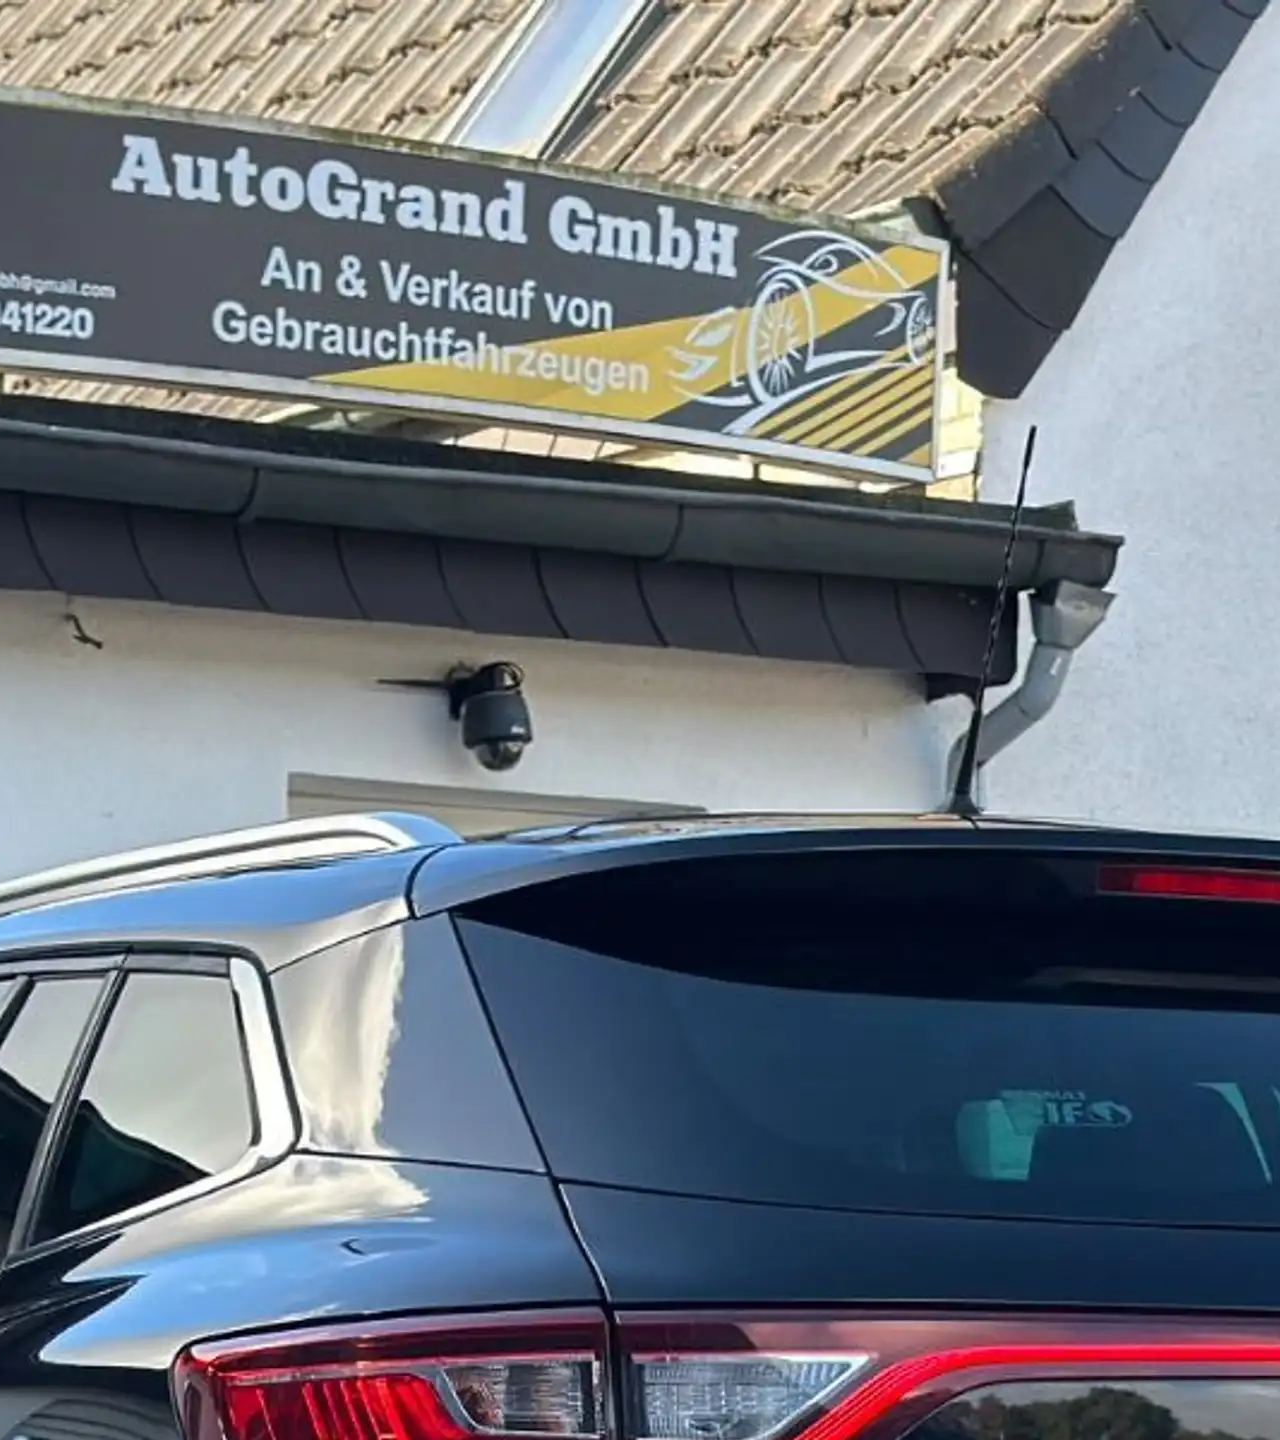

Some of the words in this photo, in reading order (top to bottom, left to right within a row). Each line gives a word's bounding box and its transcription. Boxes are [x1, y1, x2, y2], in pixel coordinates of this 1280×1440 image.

[111, 134, 527, 242] AutoGrand
[549, 196, 738, 278] GmbH
[261, 246, 323, 293] An
[336, 255, 367, 299] &
[380, 261, 535, 320] Verkauf
[544, 295, 614, 331] von
[212, 301, 650, 393] Gebrauchtfahrzeugen
